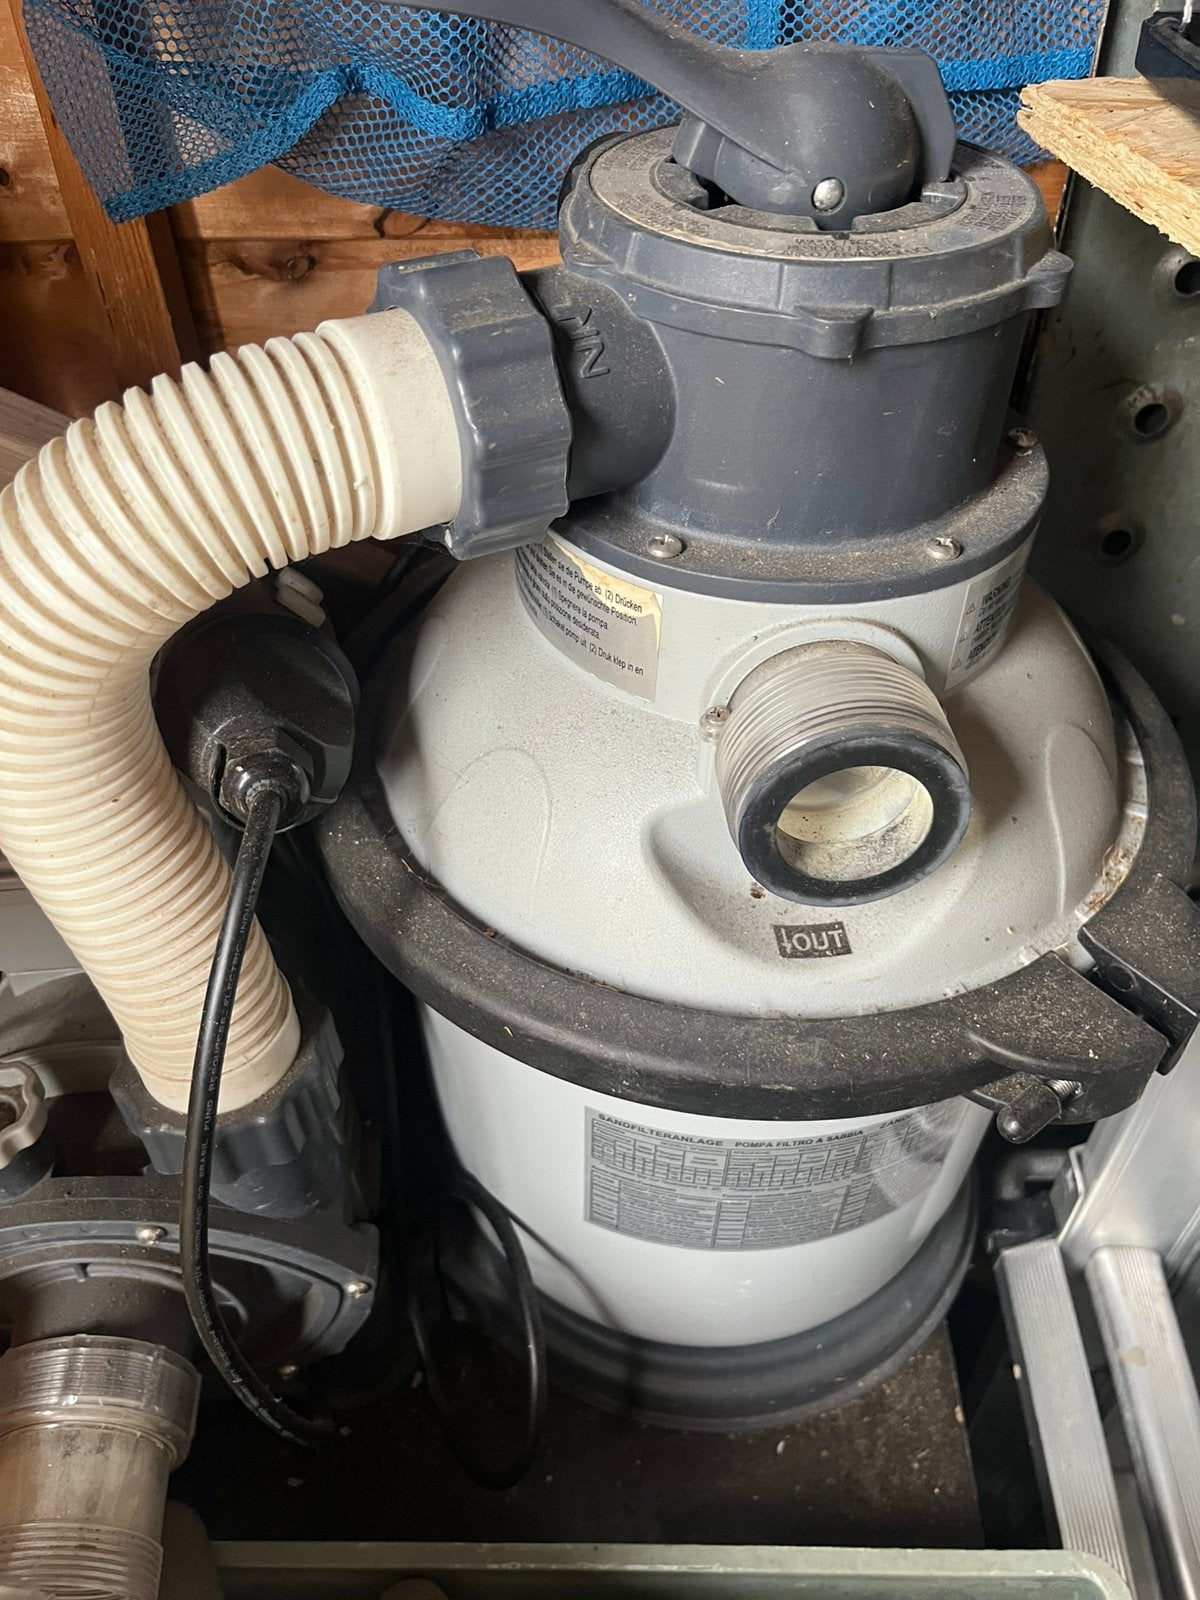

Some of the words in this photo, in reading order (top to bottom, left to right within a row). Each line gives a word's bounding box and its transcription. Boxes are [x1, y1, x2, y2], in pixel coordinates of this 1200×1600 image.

[571, 329, 610, 379] IN
[563, 580, 568, 588] in
[568, 583, 576, 594] die
[577, 589, 610, 614] gewünschte
[611, 606, 639, 627] Position.
[574, 571, 593, 591] Pumpe
[594, 585, 602, 595] ab.
[605, 590, 613, 603] (2)
[615, 593, 642, 613] Drücken
[572, 616, 601, 640] desiderata.
[582, 607, 588, 618] la
[588, 612, 609, 631] pompa.
[566, 627, 579, 643] pomp
[589, 643, 598, 656] (2)
[598, 648, 612, 662] Druk
[613, 655, 626, 670] klep
[627, 662, 634, 672] in
[635, 666, 644, 676] en
[792, 929, 843, 951] OUT
[199, 1139, 208, 1178] BRASIL
[204, 1099, 214, 1131] FUND
[599, 1113, 724, 1147] SANDFILTERANLAGE
[735, 1140, 772, 1149] POMPA
[776, 1137, 813, 1148] FILTRO
[816, 1136, 824, 1144] A
[827, 1130, 864, 1142] SABBIA
